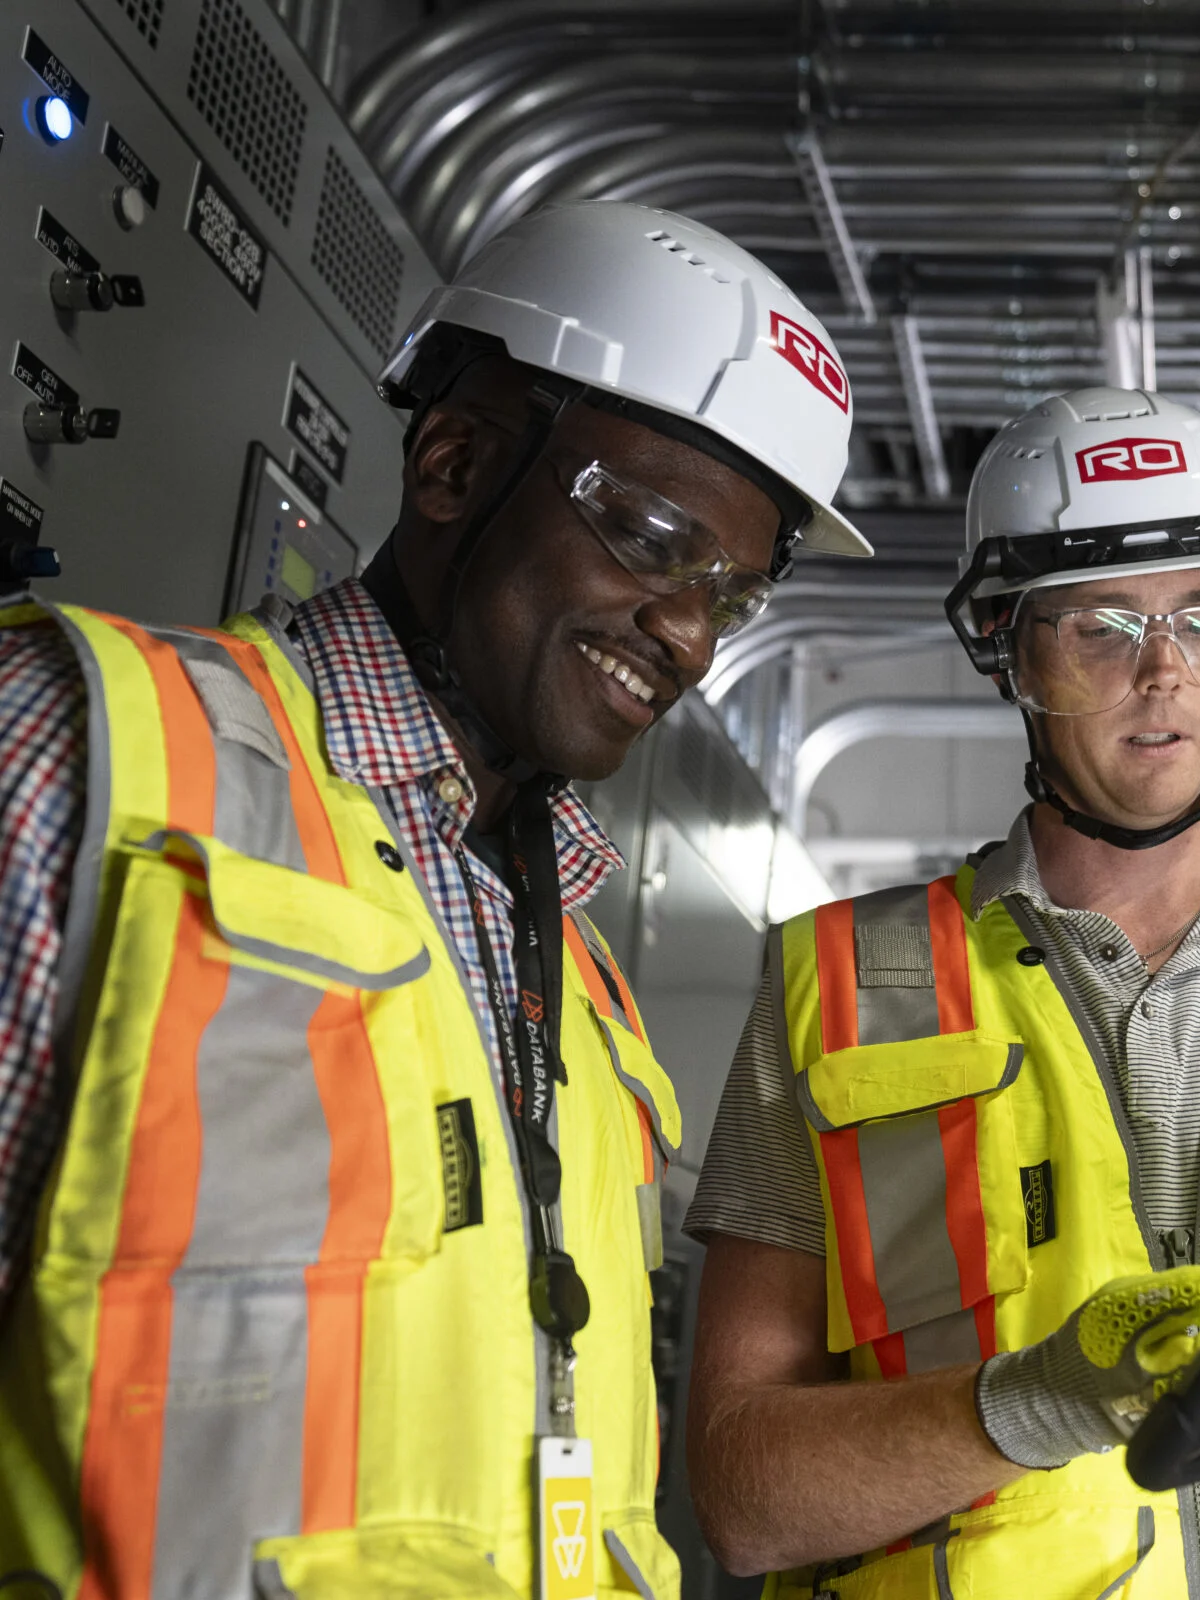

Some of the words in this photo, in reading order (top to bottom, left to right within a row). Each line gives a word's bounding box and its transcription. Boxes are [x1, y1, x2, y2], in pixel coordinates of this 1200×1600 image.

[42, 66, 71, 100] MODE
[47, 55, 72, 88] AUTO
[39, 230, 60, 255] AUTO
[199, 221, 246, 285] SECTION
[247, 279, 255, 295] 1
[41, 368, 59, 390] GEN
[777, 319, 846, 404] RO
[16, 365, 33, 384] OFF
[34, 382, 55, 406] AUTO
[1083, 442, 1180, 477] RO
[492, 977, 522, 1086] DATABANK
[526, 1021, 547, 1124] DATABANK
